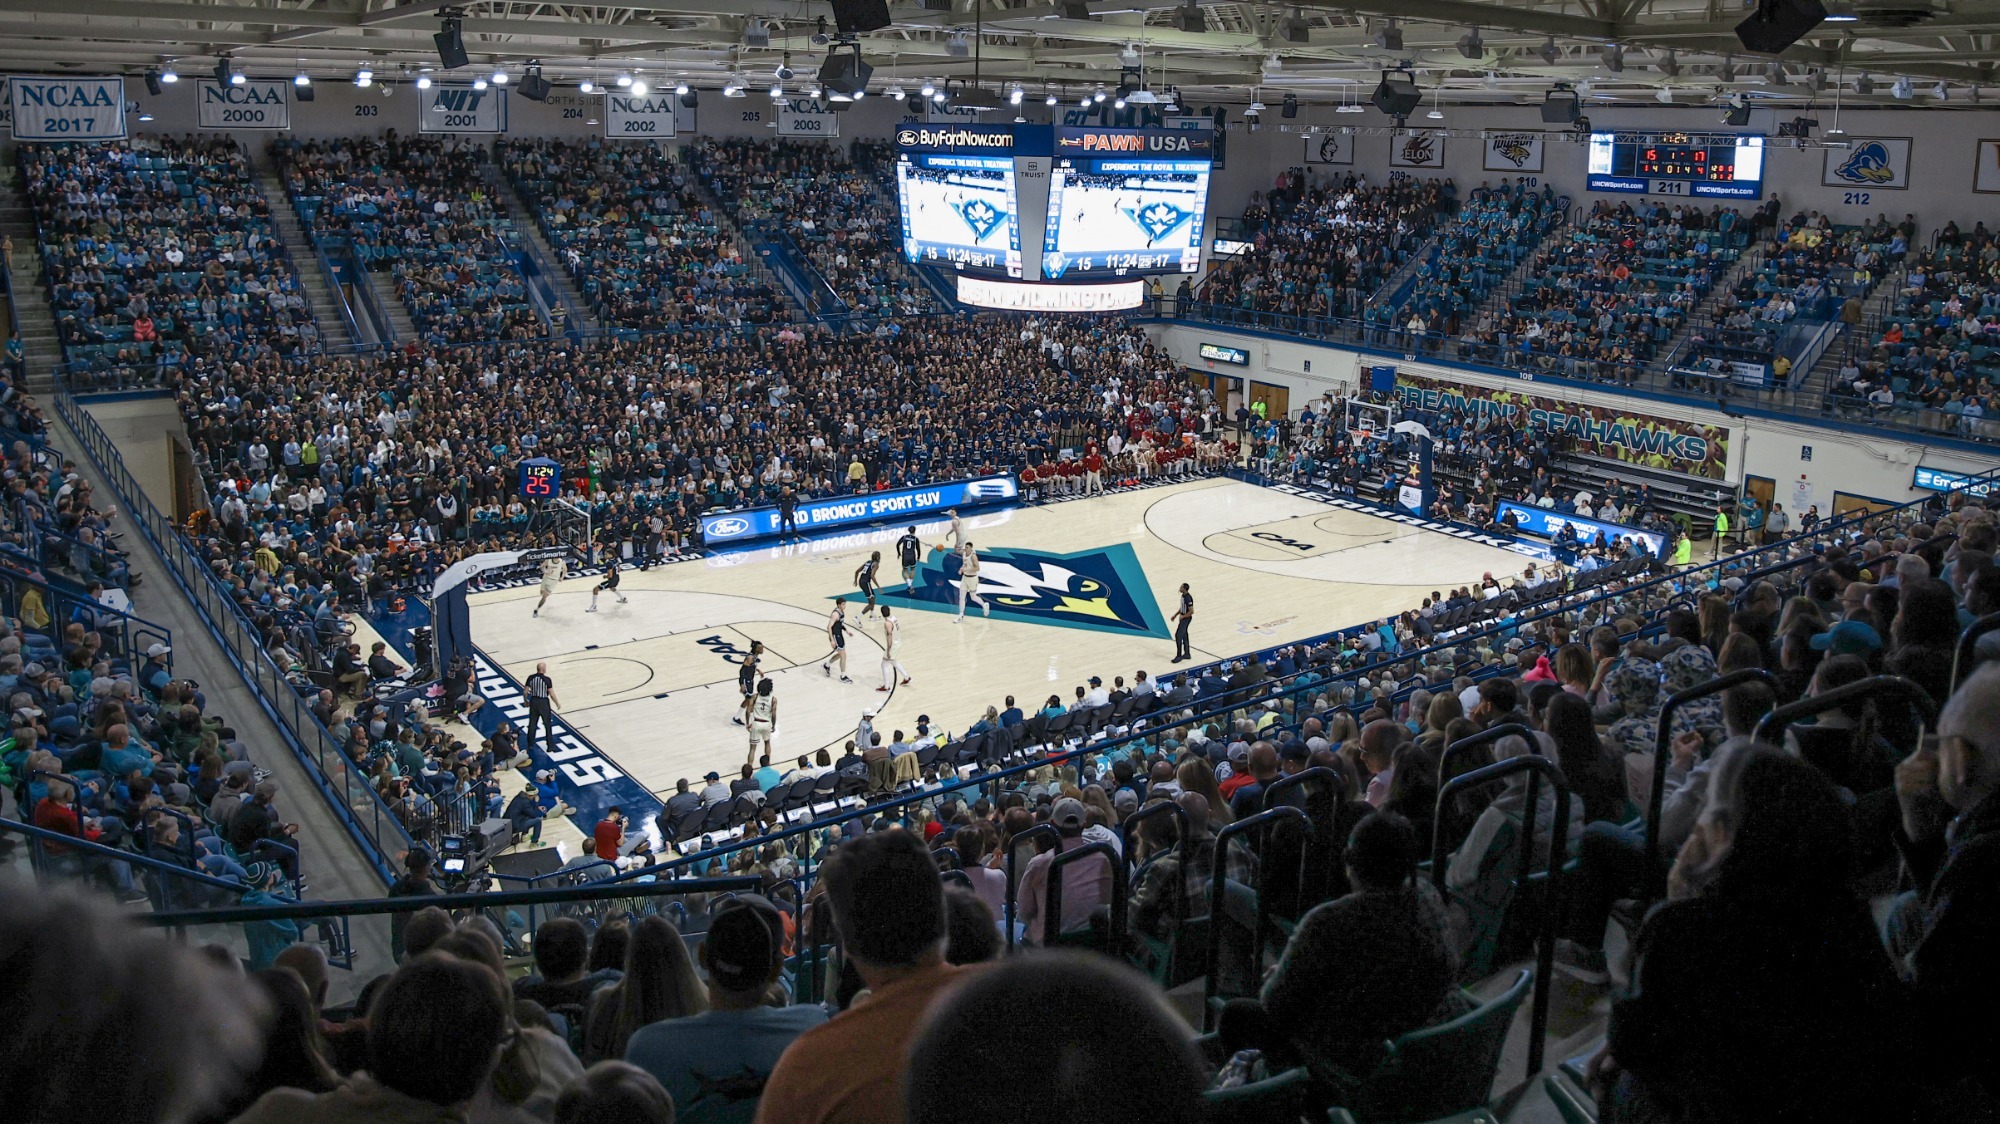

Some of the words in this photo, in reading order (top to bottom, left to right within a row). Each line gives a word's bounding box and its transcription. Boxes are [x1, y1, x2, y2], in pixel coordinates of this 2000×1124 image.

[20, 85, 114, 107] NCAA
[204, 86, 284, 104] NCAA
[433, 90, 487, 111] NIT
[579, 97, 603, 106] SIDE
[612, 97, 672, 113] NCAA
[223, 110, 264, 122] 2000
[355, 105, 378, 116] 203
[563, 109, 583, 119] 204
[445, 115, 477, 126] 2001
[742, 112, 760, 121] 205
[45, 118, 95, 132] 2017
[624, 121, 656, 132] 2002
[793, 120, 821, 130] 2003
[920, 129, 1013, 148] BuyFordNow.com
[1084, 134, 1144, 151] PAWN
[1150, 136, 1190, 152] USA
[1405, 150, 1434, 160] ELON
[1646, 150, 1657, 160] 15
[1694, 151, 1706, 161] 17
[1102, 163, 1140, 171] EXPERIENCE
[1140, 163, 1152, 171] THE
[1153, 163, 1174, 171] ROYAL
[1175, 164, 1210, 172] TREATMENT
[1684, 166, 1691, 174] 4
[1389, 171, 1405, 181] 209
[1592, 181, 1643, 189] UNCWSports.com
[1658, 182, 1681, 193] 211
[1696, 186, 1753, 195] UNCWSports.com
[1556, 198, 1570, 210] W
[1844, 192, 1870, 205] 212
[927, 247, 938, 260] 15
[946, 247, 971, 263] 11:24
[985, 254, 996, 268] 17
[1077, 257, 1092, 271] 15
[1106, 254, 1137, 268] 11:24
[1140, 256, 1151, 268] 25
[1156, 254, 1170, 268] 17
[1520, 372, 1533, 380] 108
[1529, 408, 1706, 461] SEAHAWKS
[528, 467, 554, 476] 11:24
[526, 476, 550, 494] 25
[713, 520, 743, 534] Ford
[872, 495, 914, 514] SPORT
[916, 492, 940, 507] SUV
[1268, 484, 1548, 557] SEAHAWKS
[1544, 515, 1565, 526] FORD
[906, 541, 912, 549] 0
[1251, 532, 1315, 550] CAA
[526, 550, 568, 561] TicketSmarter
[760, 702, 766, 710] 3
